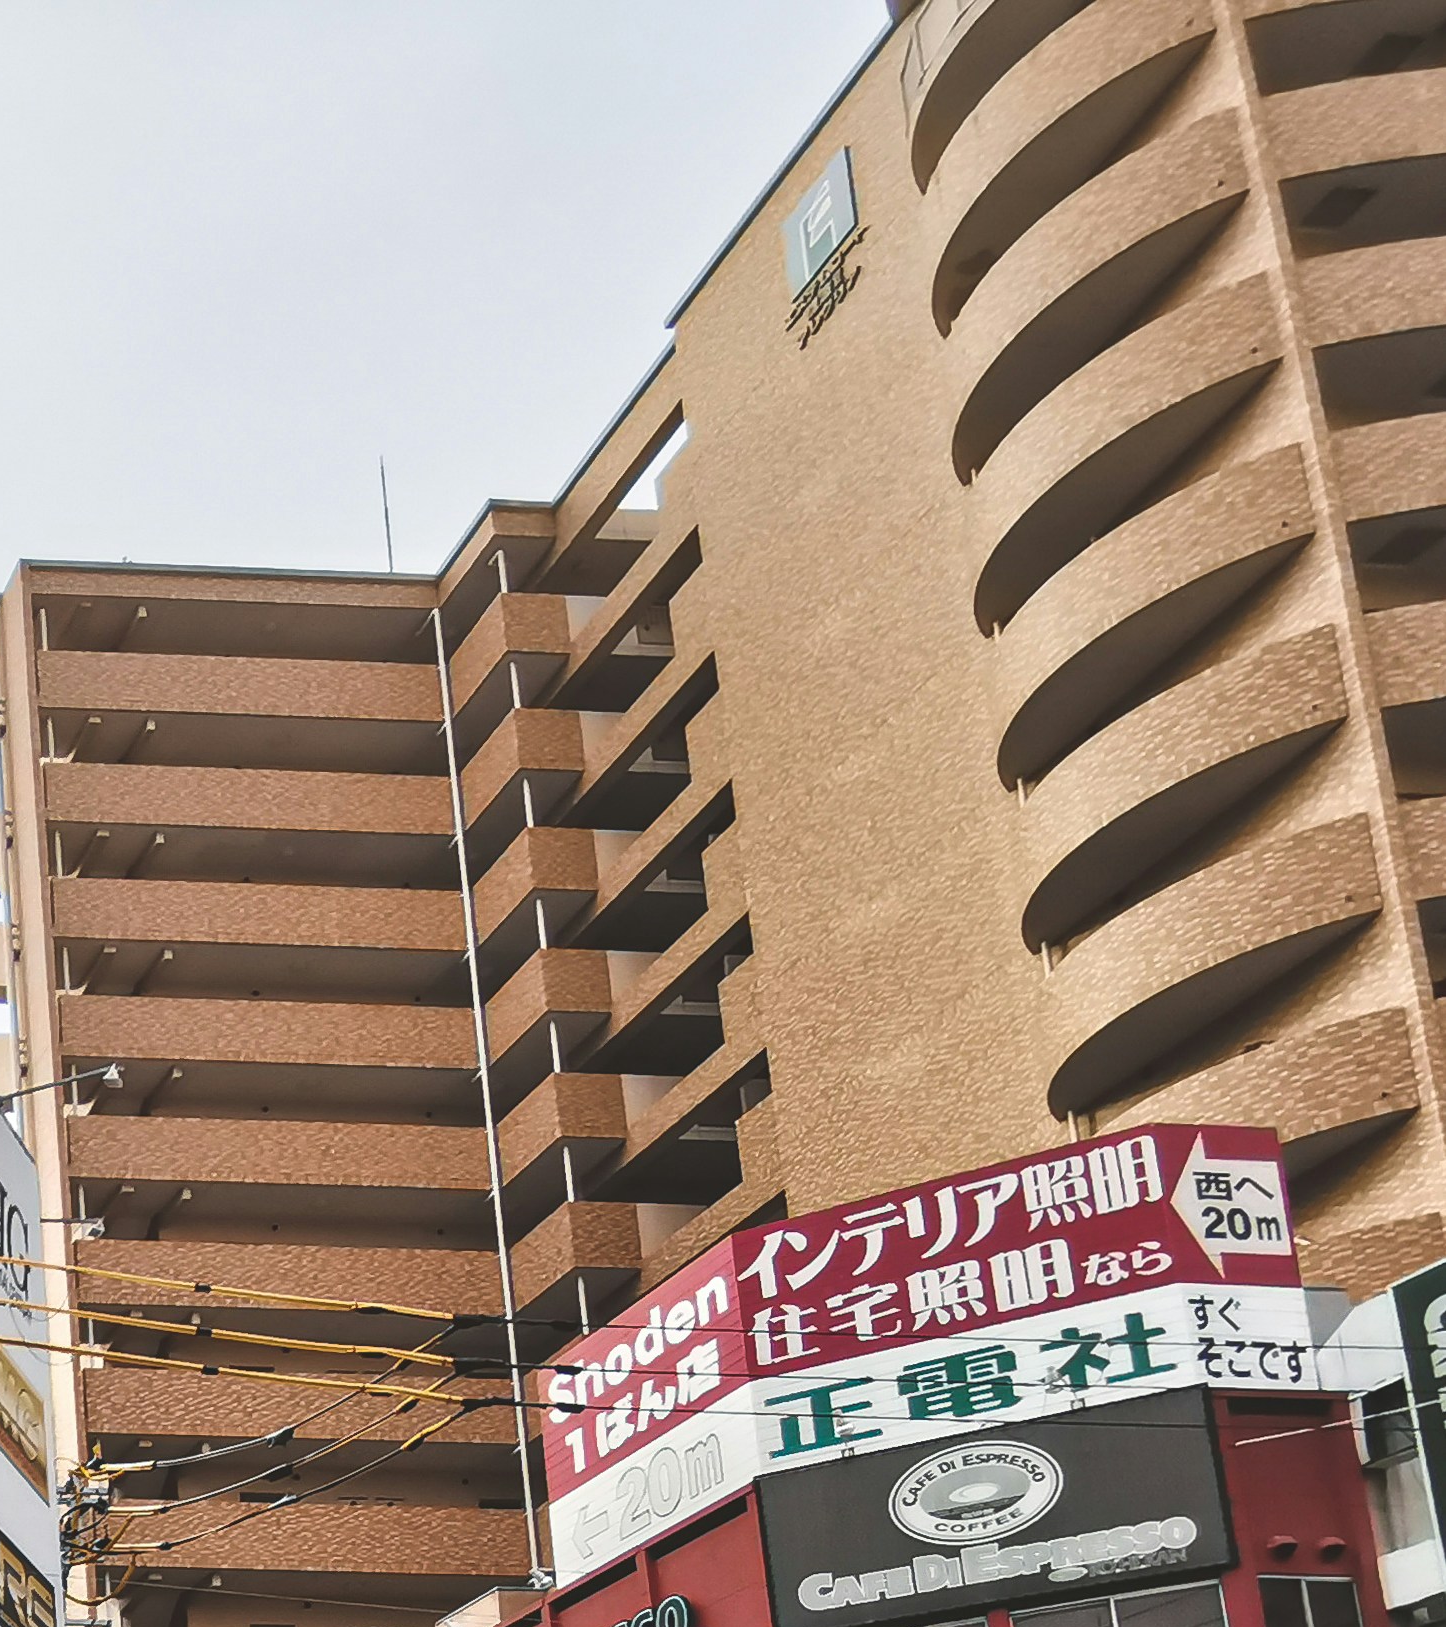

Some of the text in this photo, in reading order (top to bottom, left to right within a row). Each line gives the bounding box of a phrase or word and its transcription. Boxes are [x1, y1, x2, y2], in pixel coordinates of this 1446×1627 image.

[737, 1134, 1164, 1300] インテリア照明
[1192, 1169, 1275, 1202] 西へ
[548, 1275, 729, 1424] Shoden
[748, 1236, 1173, 1367] 住宅照明なら
[1187, 1294, 1243, 1331] すぐ
[564, 1338, 721, 1474] 1ばん店
[764, 1313, 1177, 1460] 正電社
[1197, 1339, 1308, 1384] そこです
[902, 1469, 936, 1508] CAFE
[962, 1452, 1047, 1484] ESPRESSO
[933, 1507, 1025, 1534] COFFEE
[798, 1565, 915, 1611] CAFE
[960, 1515, 1198, 1586] ESPRESSO
